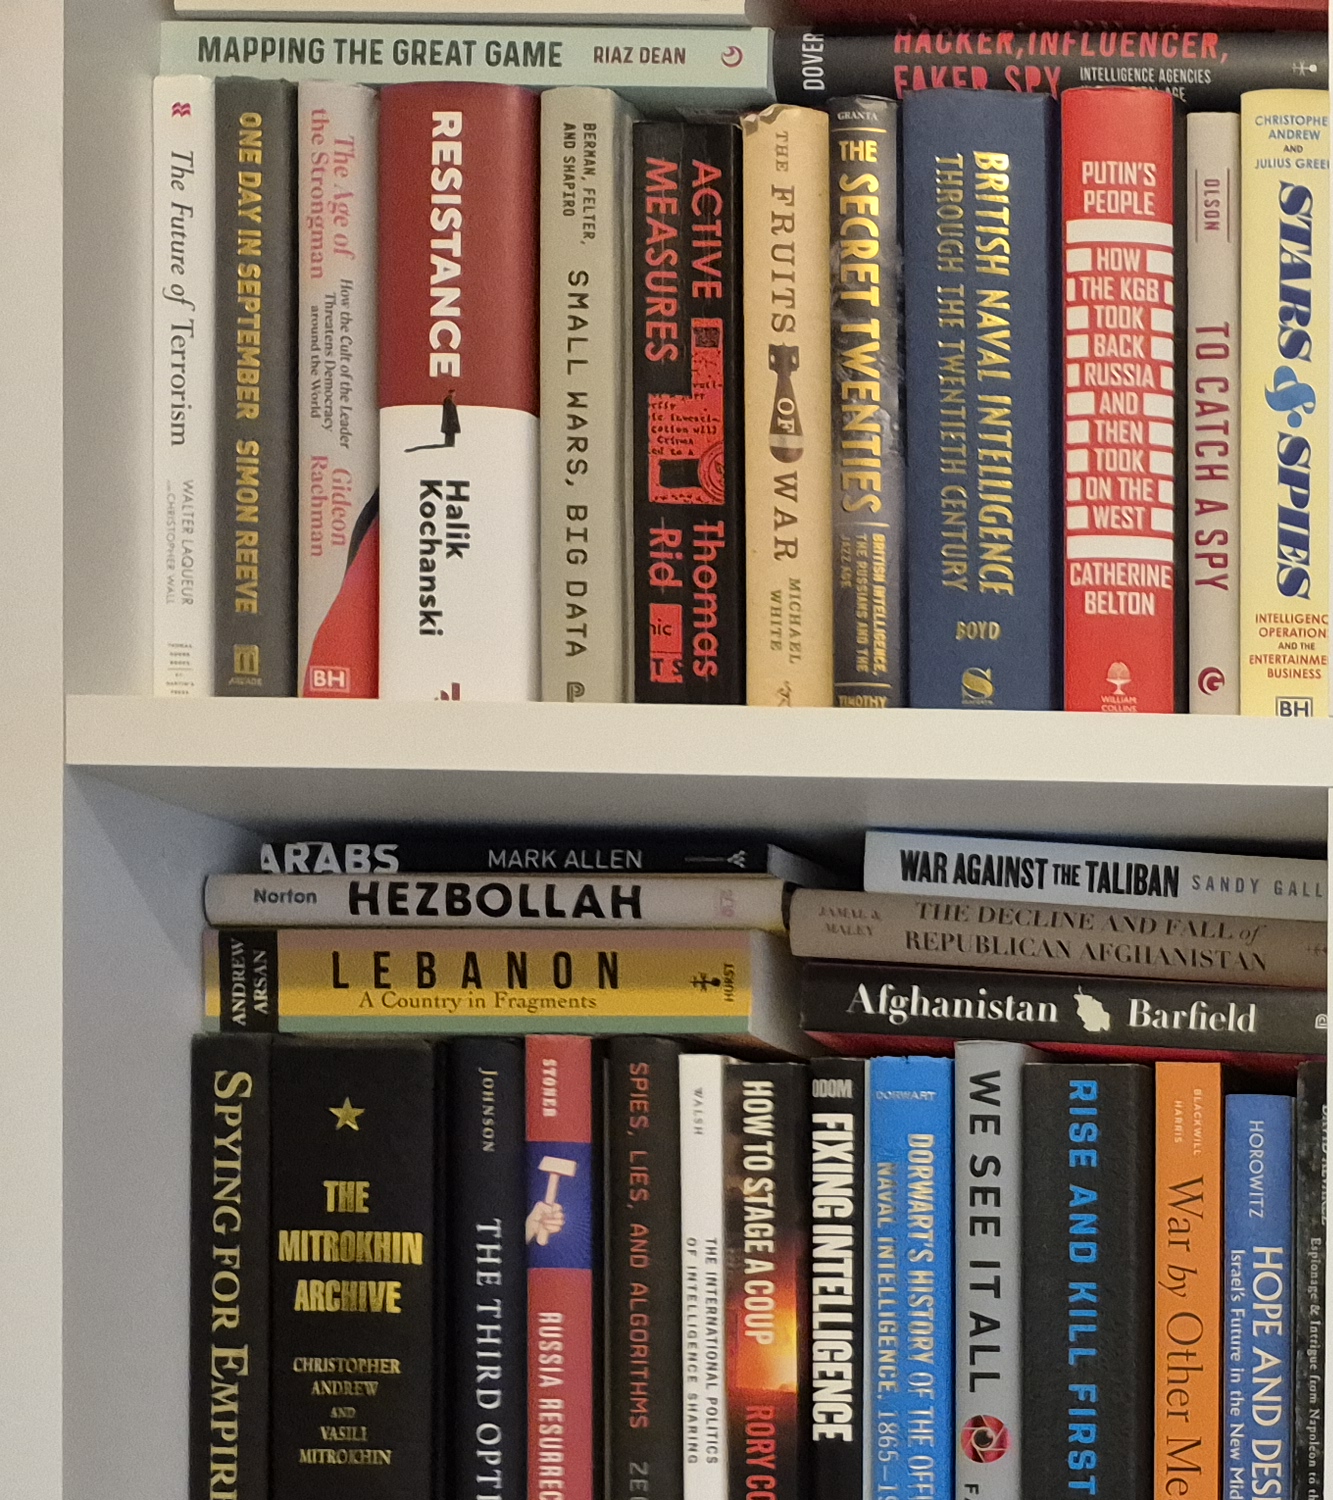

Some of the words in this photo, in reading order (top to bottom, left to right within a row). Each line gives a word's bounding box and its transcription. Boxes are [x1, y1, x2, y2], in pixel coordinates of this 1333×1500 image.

[199, 37, 324, 64] MAPPING
[334, 39, 383, 64] THE
[393, 39, 476, 66] GREAT
[486, 41, 562, 67] GAME
[594, 46, 633, 63] RIAZ
[640, 47, 685, 64] DEAN
[839, 140, 877, 163] THE
[1083, 161, 1156, 186] PUTIN'S
[1084, 190, 1154, 215] PEOPLE
[429, 112, 462, 377] RESISTANCE
[838, 174, 880, 307] SECRET
[838, 321, 882, 513] TWENTIES
[444, 480, 470, 558] Halik
[419, 480, 443, 635] Kochanski
[1071, 564, 1172, 587] CATHERINE
[1085, 591, 1154, 615] BELTON
[489, 849, 556, 868] MARK
[564, 849, 642, 869] ALLEN
[901, 850, 947, 883] WAR
[953, 853, 1048, 889] AGAINST
[1053, 864, 1081, 886] THE
[1085, 861, 1179, 897] TALIBAN
[349, 881, 641, 919] HEZBOLLAH
[332, 951, 618, 989] LEBANON
[359, 992, 373, 1007] A
[381, 992, 461, 1013] Country
[469, 993, 485, 1008] in
[495, 992, 596, 1013] Fragments
[849, 984, 1057, 1024] Afghanistan
[1129, 999, 1256, 1032] Barfield
[294, 1280, 401, 1313] ARCHIVE
